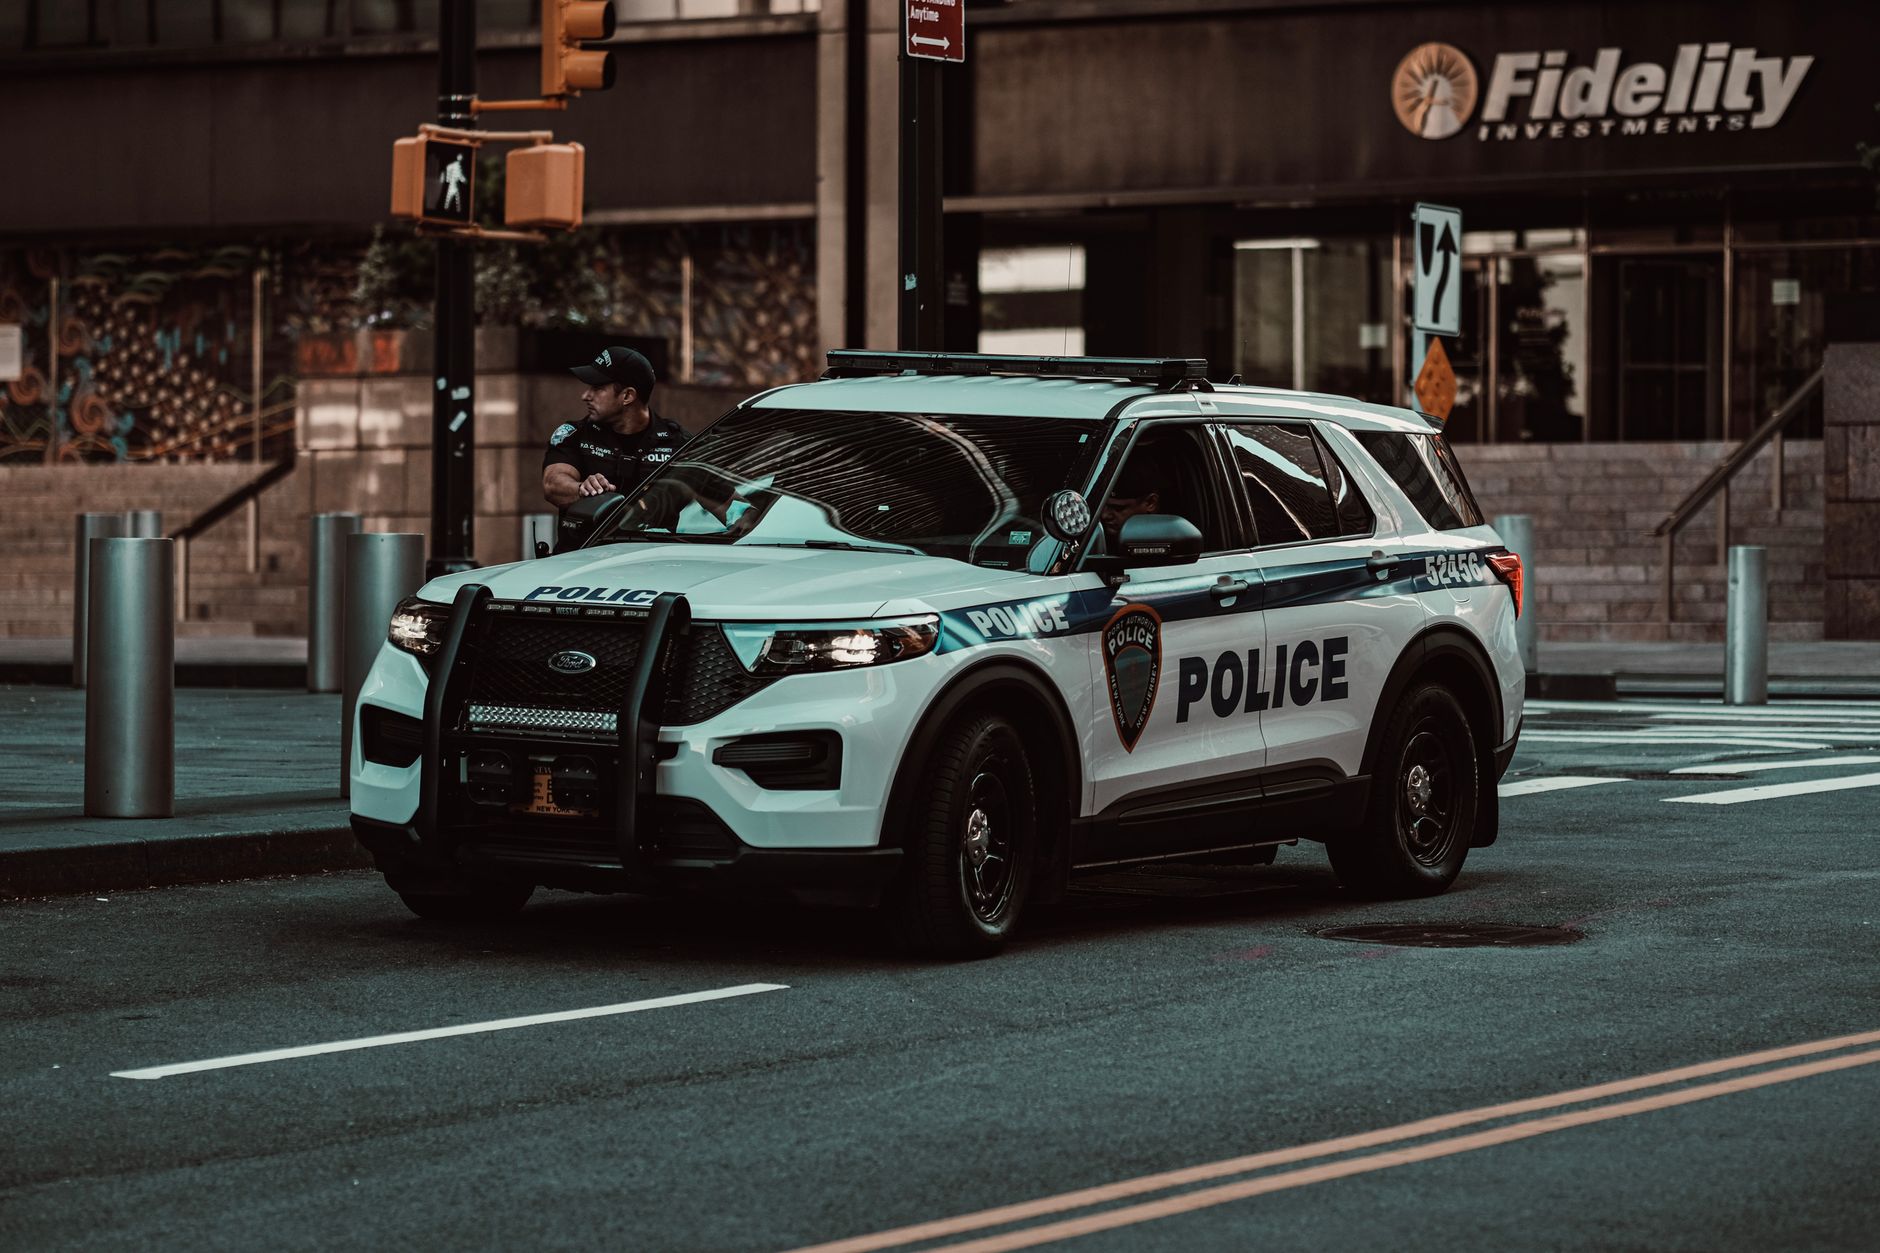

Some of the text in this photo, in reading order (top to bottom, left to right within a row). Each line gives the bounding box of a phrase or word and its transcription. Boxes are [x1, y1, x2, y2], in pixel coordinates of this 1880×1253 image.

[910, 5, 940, 23] Anytime
[1480, 42, 1815, 129] Fidelity
[1478, 113, 1746, 142] INVESTMENTS
[1425, 552, 1483, 586] 52456
[966, 600, 1070, 638] POLICE
[1107, 615, 1157, 640] PORT AUTHORITY
[1108, 626, 1154, 656] POLICE
[556, 655, 585, 669] Ford
[1136, 663, 1158, 728] NEW JERSEY
[1176, 636, 1349, 724] POLICE
[1110, 674, 1126, 728] NEW YORK
[552, 806, 570, 814] YORK
